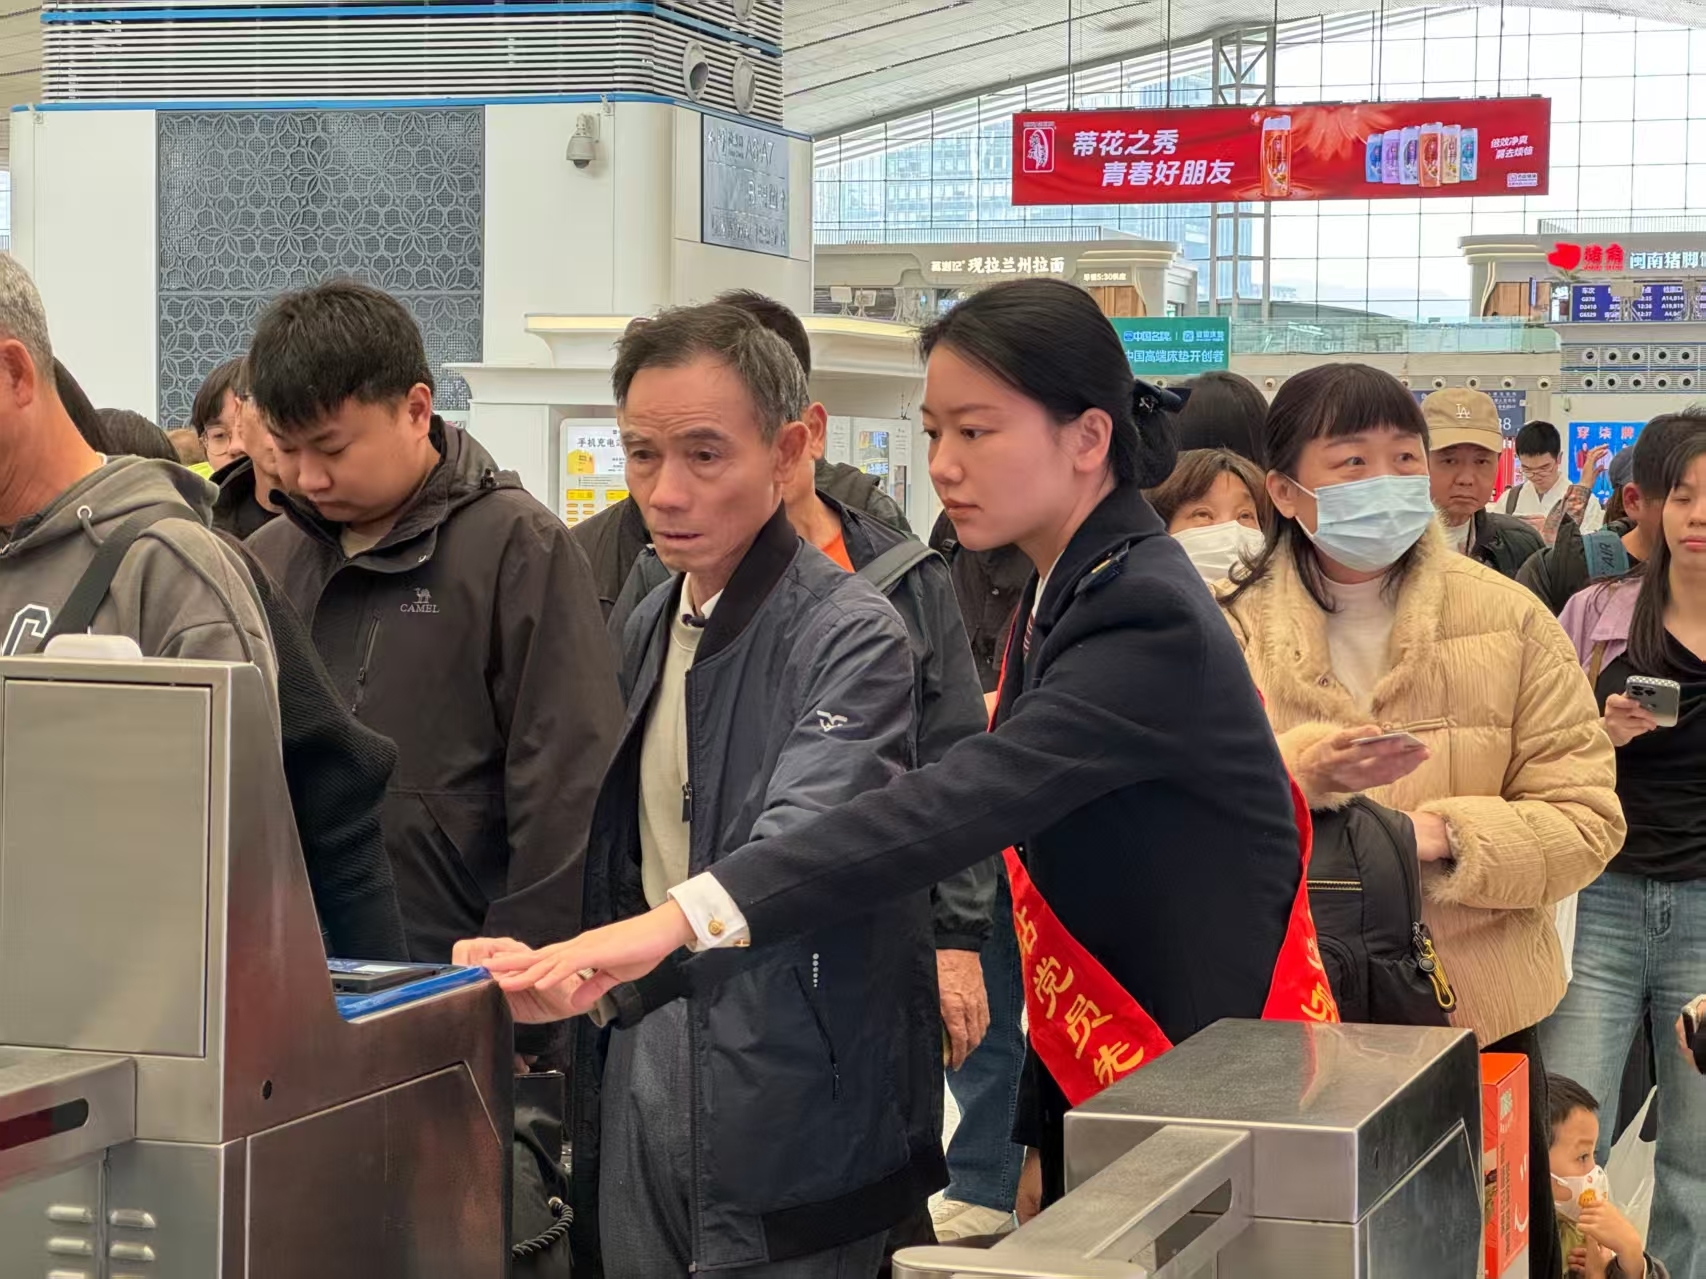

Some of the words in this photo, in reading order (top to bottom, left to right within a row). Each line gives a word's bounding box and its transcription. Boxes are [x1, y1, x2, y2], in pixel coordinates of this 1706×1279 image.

[1072, 129, 1179, 157] 蒂花之秀
[1101, 159, 1235, 187] 青春好朋友
[967, 256, 1065, 274] 现拉兰州拉面
[1125, 349, 1225, 363] 中国高端床垫开创者
[1455, 403, 1471, 419] LA
[399, 603, 441, 614] CAMEL
